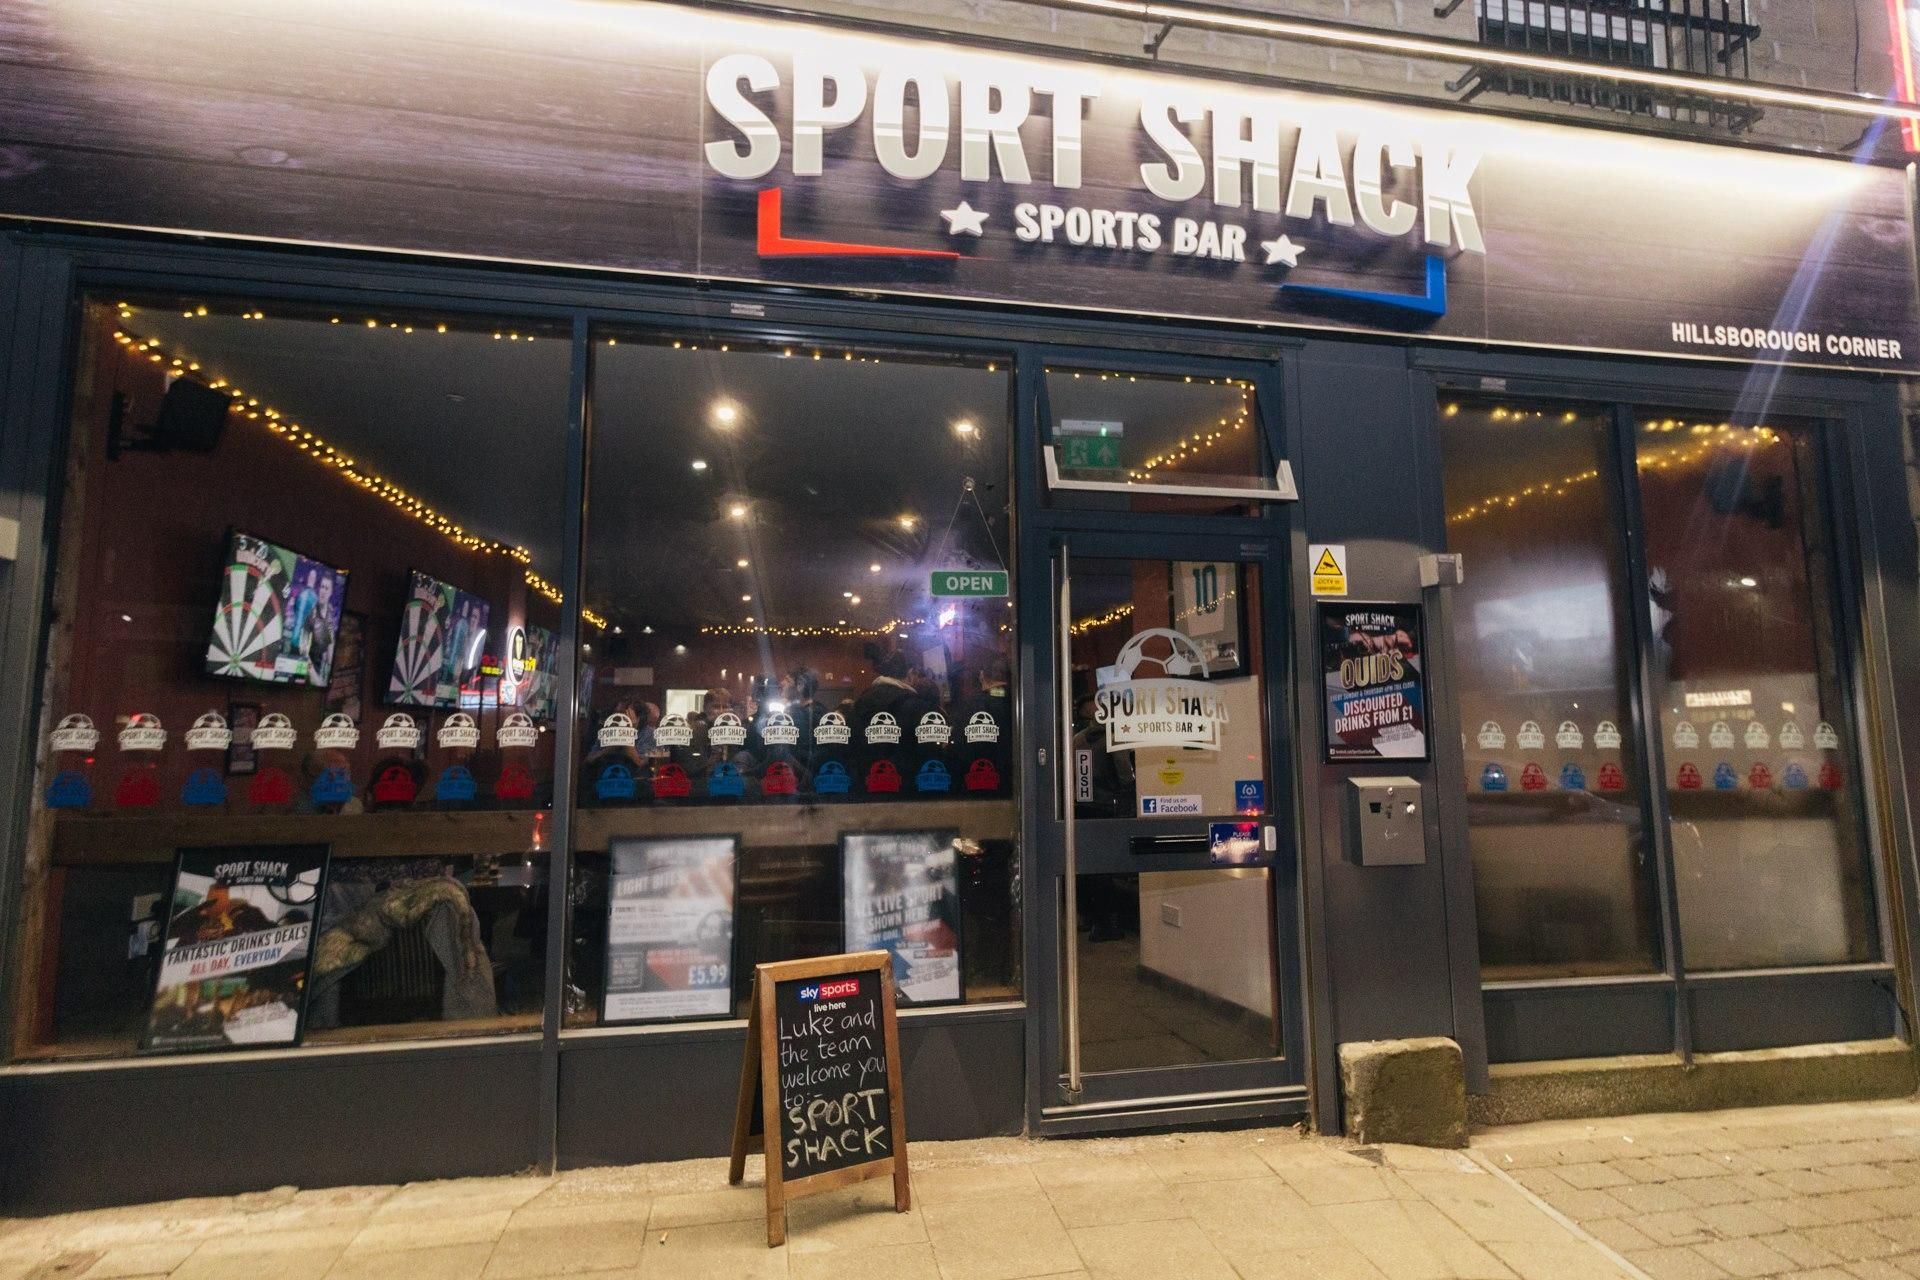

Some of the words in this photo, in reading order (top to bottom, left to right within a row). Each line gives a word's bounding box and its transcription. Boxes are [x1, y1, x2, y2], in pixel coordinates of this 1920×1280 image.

[705, 50, 1100, 189] SPORT
[1140, 97, 1486, 255] SHACK
[1014, 202, 1161, 252] SPORTS
[1174, 217, 1246, 263] BAR
[1672, 322, 1821, 353] HILLSBOROUGH
[1826, 334, 1902, 359] CORNER
[946, 576, 993, 591] OPEN
[1193, 564, 1217, 616] 10
[1346, 613, 1368, 626] SPORT
[1371, 613, 1395, 627] SHACK
[1340, 648, 1404, 690] QUIDS
[1096, 687, 1156, 721] SPORT
[1166, 686, 1228, 721] SHACK
[1344, 692, 1403, 716] DISCOUNTED
[1137, 722, 1172, 734] SPORTS
[1176, 722, 1193, 733] BAR
[1335, 712, 1370, 734] DRINKS
[1374, 708, 1399, 726] FROM
[1402, 706, 1413, 720] £1
[377, 729, 398, 739] SPORT
[438, 729, 458, 738] SPORT
[498, 728, 517, 738] SPORT
[598, 729, 616, 738] SPORT
[619, 728, 638, 738] SHACK
[654, 728, 672, 738] SPORT
[674, 728, 692, 737] SHACK
[709, 727, 727, 737] SPORT
[728, 726, 746, 737] SHACK
[762, 727, 780, 737] SPORT
[781, 726, 799, 737] SHACK
[814, 726, 832, 736] SPORT
[833, 726, 850, 736] SHACK
[866, 726, 882, 736] SPORT
[884, 726, 901, 736] SHACK
[916, 726, 932, 736] SPORT
[934, 726, 950, 736] SHACK
[966, 726, 982, 736] SPORT
[982, 726, 999, 736] SHACK
[1080, 754, 1089, 798] PUSH
[1160, 804, 1198, 813] Facebook
[215, 862, 251, 879] SPORT
[253, 861, 288, 877] SHACK
[167, 943, 230, 967] FANTASTIC
[231, 934, 271, 952] DRINKS
[274, 926, 308, 944] DEALS
[190, 963, 208, 976] ALL
[210, 959, 230, 973] DAY,
[234, 947, 282, 967] EVERYDAY
[688, 964, 727, 985] £5.99
[800, 986, 819, 1000] sky
[822, 982, 856, 998] sports
[814, 1004, 827, 1013] live
[828, 1002, 846, 1012] here
[780, 1010, 834, 1040] Luke
[842, 1000, 876, 1030] and
[781, 1042, 808, 1067] the
[818, 1035, 872, 1060] team
[782, 1062, 850, 1089] welcome
[858, 1056, 886, 1088] you
[789, 1088, 885, 1136] SPORT
[786, 1125, 888, 1168] SHACK
